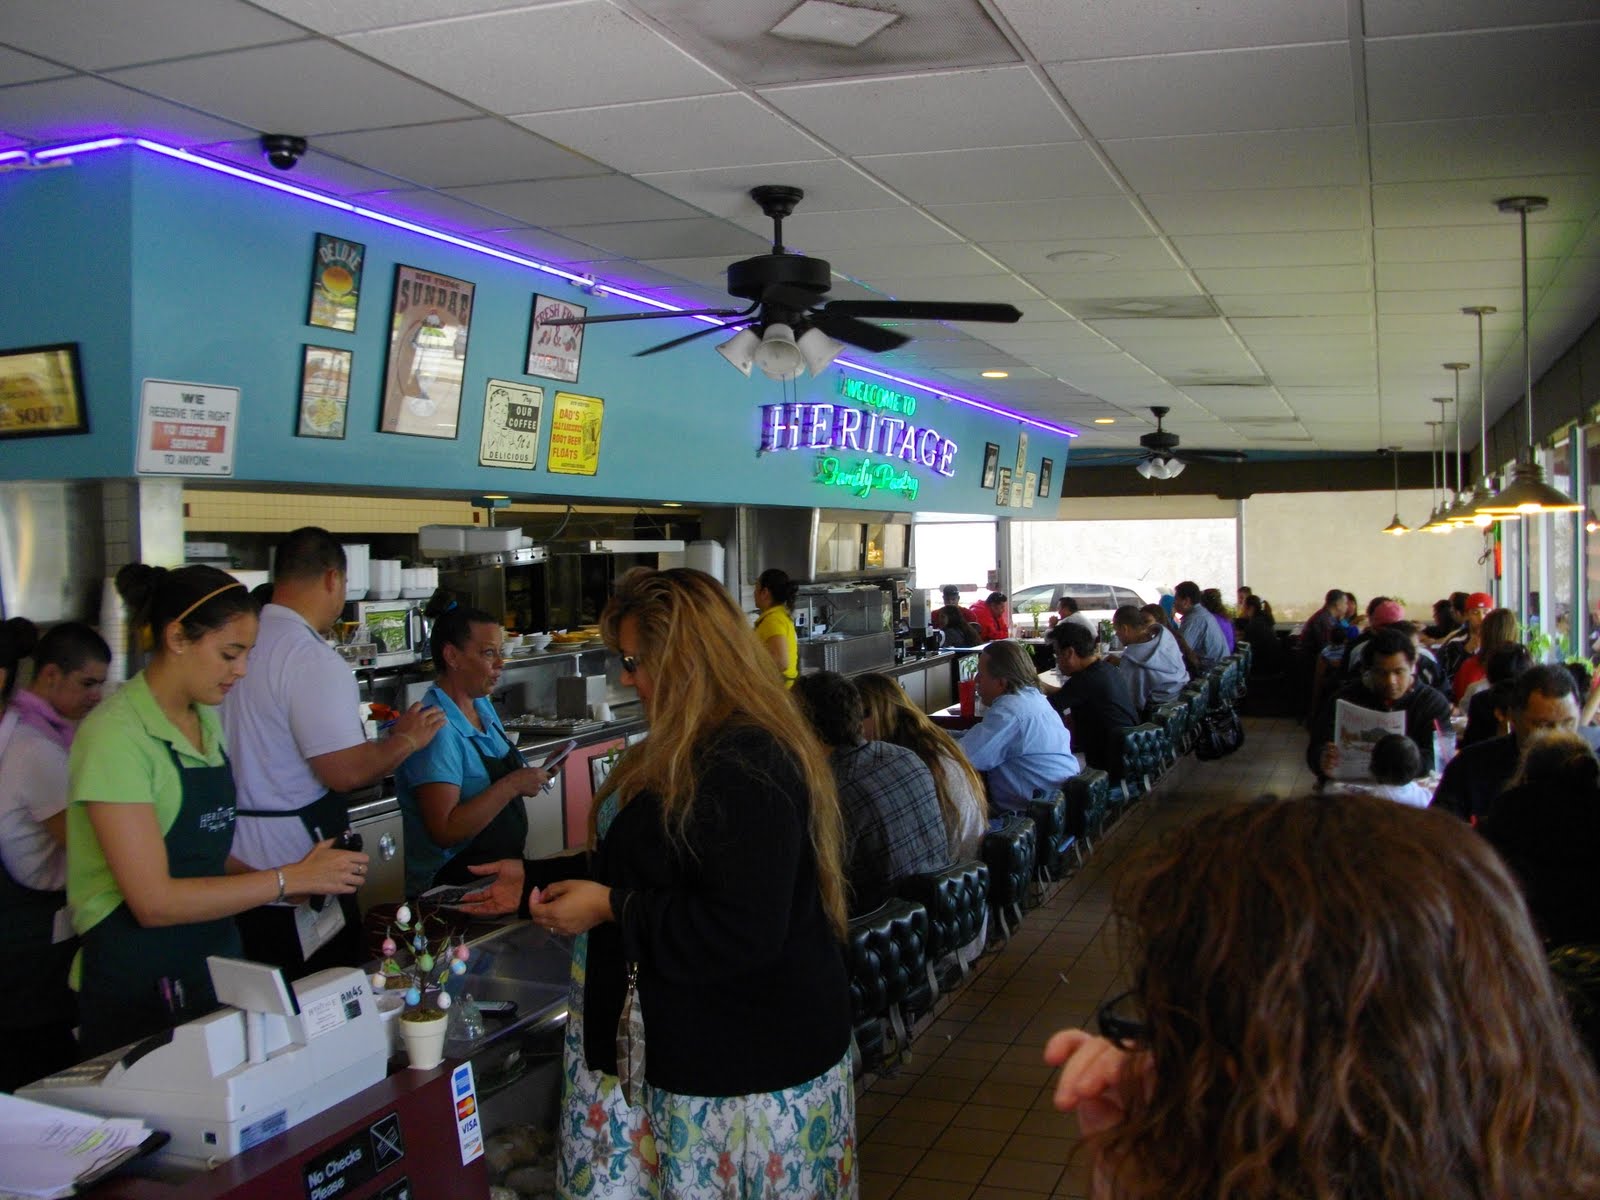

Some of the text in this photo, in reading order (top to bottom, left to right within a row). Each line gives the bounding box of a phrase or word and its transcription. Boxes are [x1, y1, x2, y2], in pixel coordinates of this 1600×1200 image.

[320, 243, 361, 271] DELUXE
[399, 279, 469, 325] SUNDAE
[181, 392, 206, 405] WE
[846, 378, 917, 416] WELCOME TO
[149, 405, 188, 419] RESERVE
[190, 408, 206, 421] THE
[516, 406, 533, 417] OUR
[559, 408, 580, 421] DAD'S
[508, 418, 537, 430] COFFEE
[770, 404, 958, 477] HERITAGE
[164, 454, 211, 466] TO ANYONE
[489, 451, 529, 462] DELICIOUS
[552, 447, 578, 460] FLOATS
[462, 1118, 478, 1134] VISA
[308, 1147, 363, 1189] No Checks
[311, 1175, 346, 1200] Please
